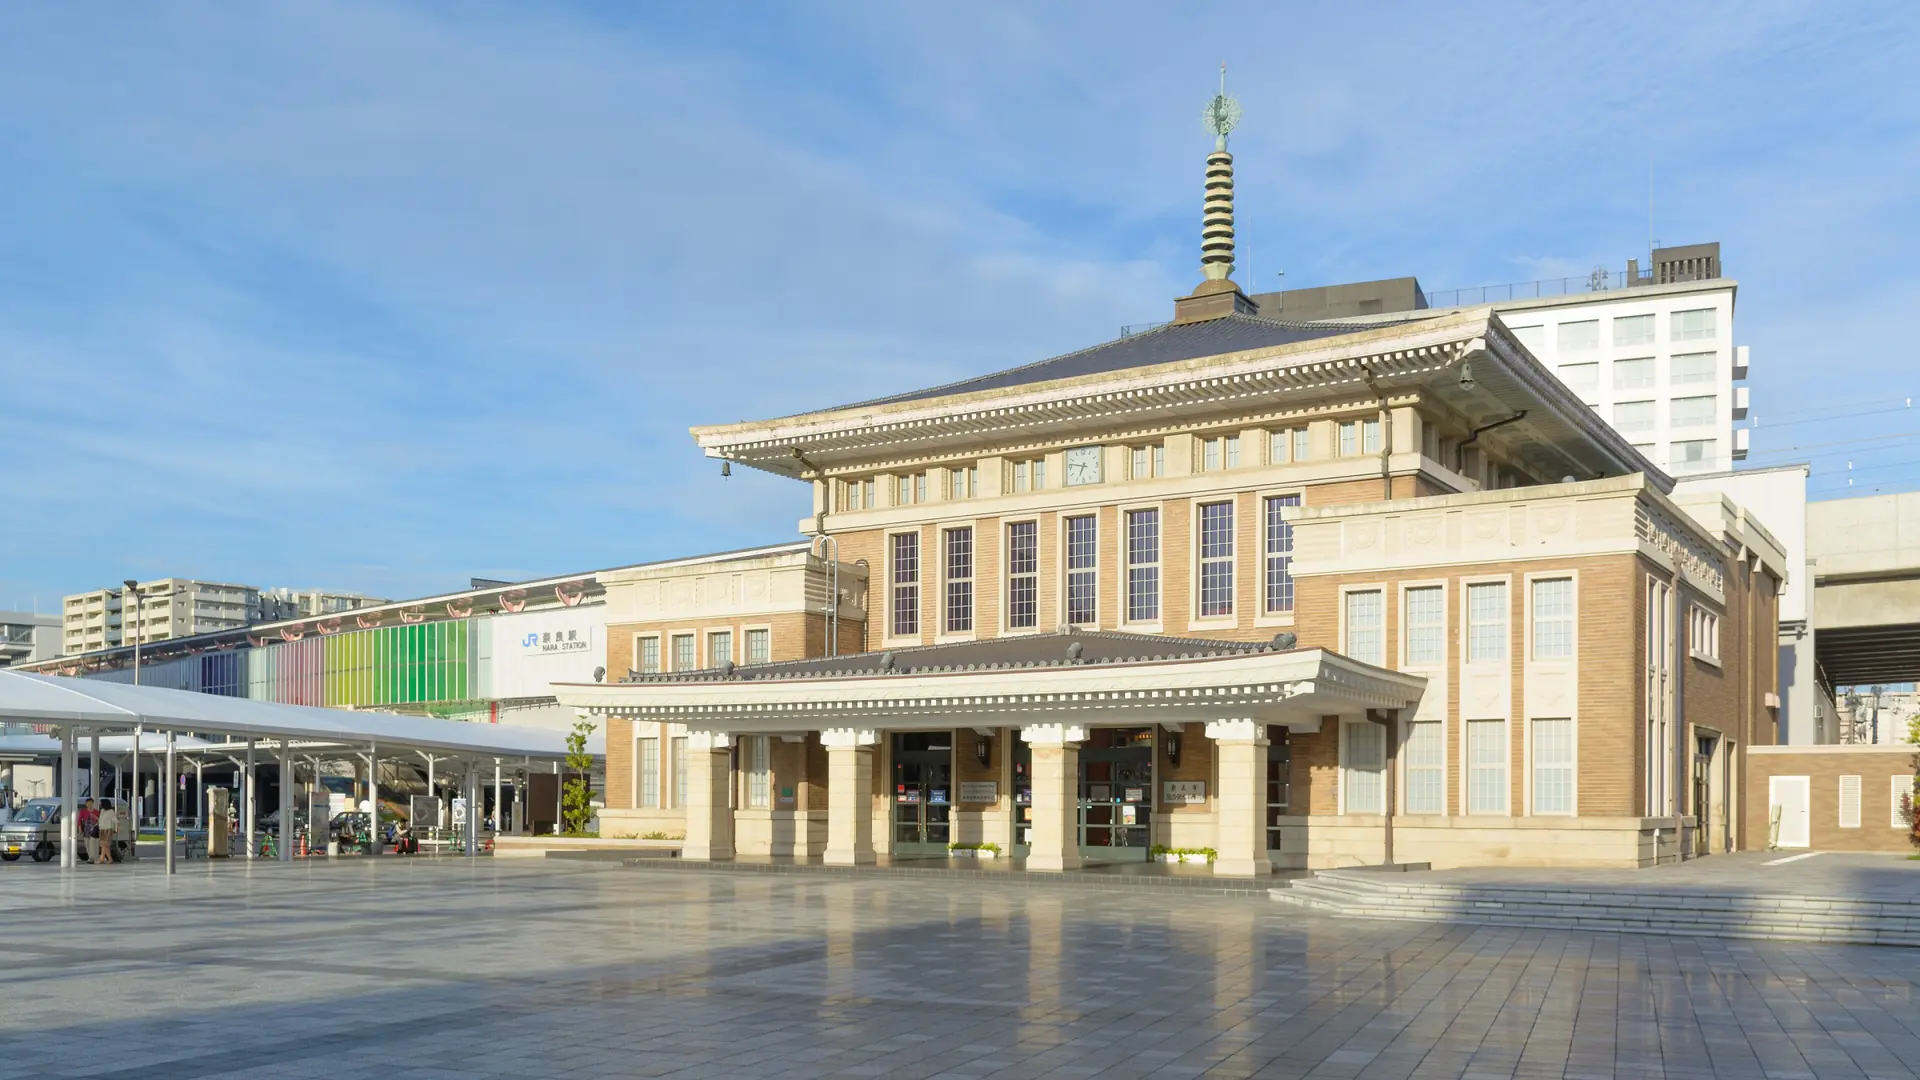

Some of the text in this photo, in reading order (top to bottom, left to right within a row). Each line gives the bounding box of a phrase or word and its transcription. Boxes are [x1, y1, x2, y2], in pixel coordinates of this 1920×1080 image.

[522, 633, 538, 647] JR
[542, 629, 577, 643] 奈良駅
[542, 641, 587, 652] NARA STATION
